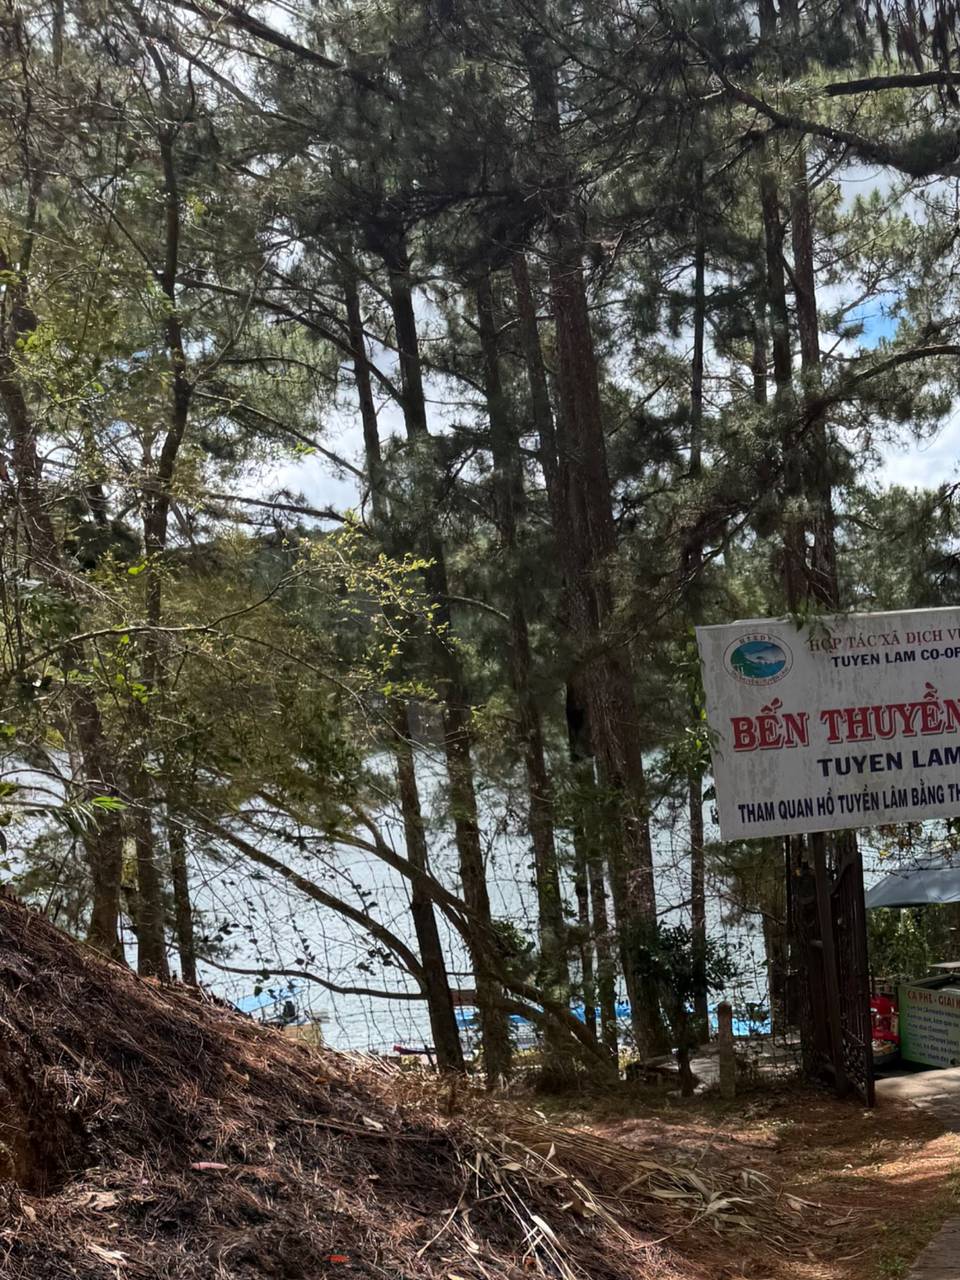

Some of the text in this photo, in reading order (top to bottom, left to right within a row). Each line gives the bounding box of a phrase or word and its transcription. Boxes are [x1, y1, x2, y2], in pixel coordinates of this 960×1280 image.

[832, 653, 880, 668] TUYEN
[885, 650, 916, 664] LAM
[730, 697, 810, 753] BẾN
[817, 753, 903, 777] TUYEN
[738, 801, 776, 824] THAM
[779, 797, 814, 819] QUAN
[817, 788, 834, 816] HỒ
[838, 784, 879, 813] TUYỀN
[882, 786, 909, 809] LÂM
[911, 779, 945, 806] BẰNG
